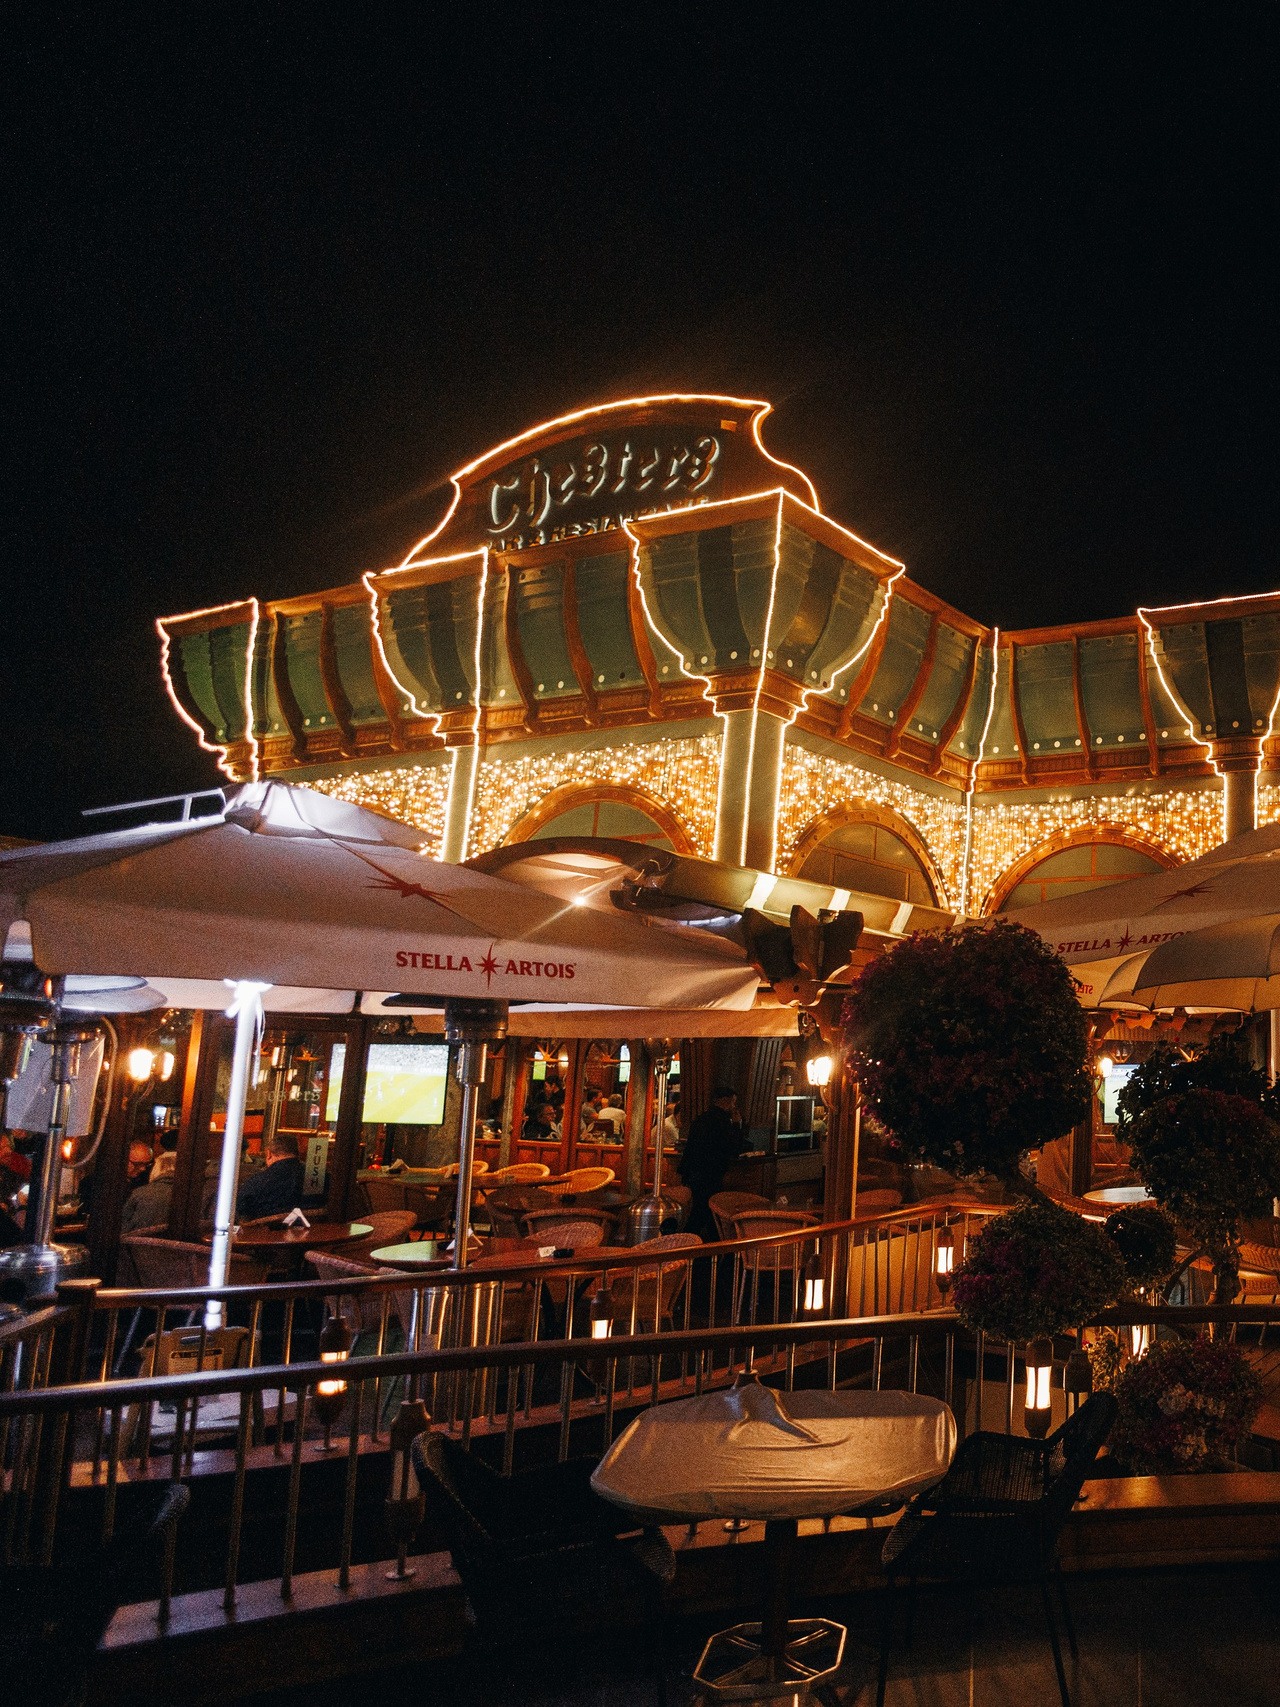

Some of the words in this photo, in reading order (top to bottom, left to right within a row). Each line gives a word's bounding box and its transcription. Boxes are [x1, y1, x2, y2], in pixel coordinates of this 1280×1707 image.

[486, 434, 721, 533] Chesters
[1056, 938, 1112, 954] STELLA
[396, 950, 473, 972] STELLA
[505, 959, 576, 979] ARTOIS
[310, 1144, 322, 1188] PUSH
